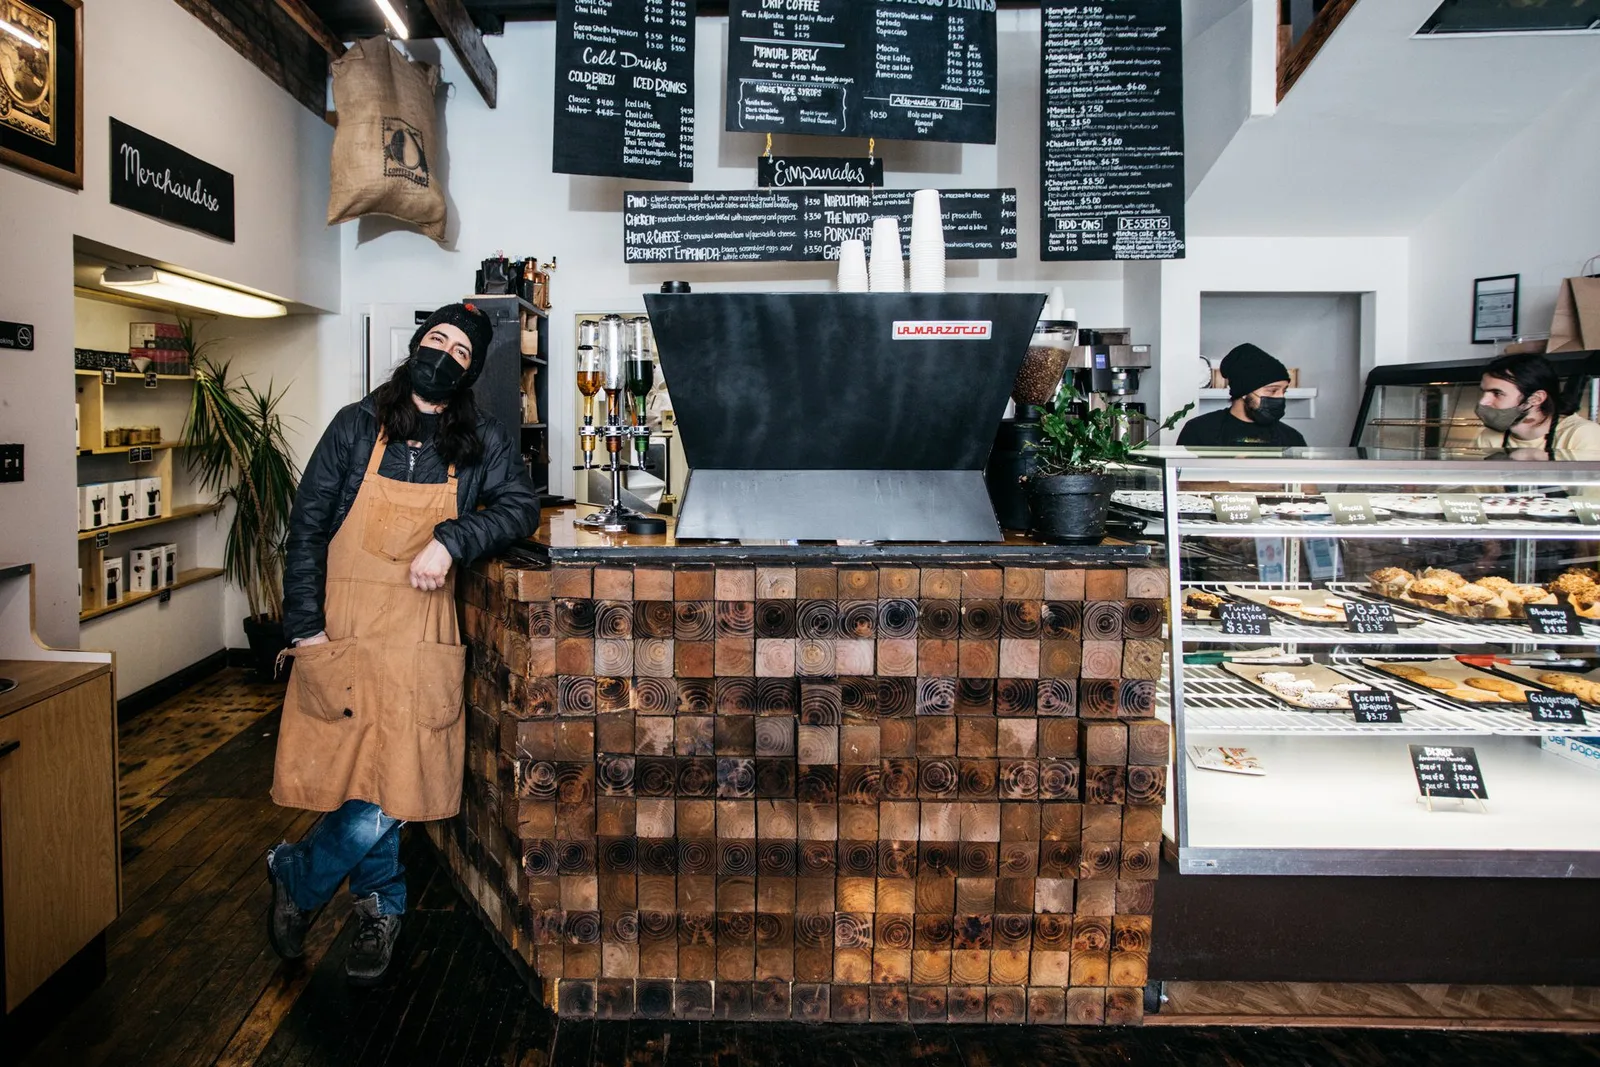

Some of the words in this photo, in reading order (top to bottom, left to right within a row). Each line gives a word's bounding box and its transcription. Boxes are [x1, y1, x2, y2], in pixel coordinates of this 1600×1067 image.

[575, 5, 588, 13] Chai
[590, 6, 607, 16] Latte
[786, 0, 820, 12] COFFEE
[817, 15, 835, 23] Roast
[876, 10, 901, 19] Espresso
[876, 19, 901, 27] Cortado
[876, 27, 908, 37] Capuccino
[574, 31, 584, 40] Hot
[586, 33, 616, 44] Chocolate
[754, 45, 789, 61] MANUAL
[792, 48, 819, 61] BREW
[876, 44, 899, 53] Mocha
[583, 47, 617, 66] Cold
[620, 52, 667, 72] Drinks
[893, 54, 911, 63] Latte
[752, 59, 764, 67] Pour
[790, 62, 810, 70] French
[811, 63, 826, 71] Press
[568, 70, 591, 82] COLD
[592, 72, 616, 85] BREW
[875, 70, 912, 79] Americano
[633, 76, 654, 90] ICED
[655, 78, 687, 94] DRINKS
[756, 85, 776, 94] HOUSE
[568, 95, 590, 104] Classic
[625, 98, 637, 107] Iced
[638, 100, 651, 110] Latte
[894, 96, 937, 107] Alternative
[939, 100, 960, 108] Milk
[625, 110, 639, 118] Chai
[639, 111, 653, 120] Latte
[870, 110, 887, 120] $0.50
[625, 120, 646, 128] Matcha
[646, 120, 661, 130] Latte
[624, 128, 636, 137] Iced
[636, 130, 665, 138] Americano
[624, 137, 637, 146] Thai
[638, 138, 646, 146] Tea
[645, 158, 662, 166] Water
[120, 143, 219, 211] Merchandise
[774, 160, 864, 187] Empanadas
[671, 195, 700, 204] empanada
[804, 196, 821, 206] $3.50
[626, 213, 658, 226] CHICKEN:
[657, 214, 686, 223] marinated
[686, 214, 704, 222] chicken
[715, 213, 730, 221] baked
[731, 213, 743, 221] with
[743, 213, 766, 223] rosemary
[766, 213, 776, 221] and
[804, 213, 821, 221] $3.50
[825, 211, 842, 224] THE
[843, 210, 871, 224] NOMAD:
[952, 211, 983, 220] prosciutto.
[1058, 219, 1101, 230] ADD-ONS
[1120, 217, 1168, 229] DESSERTS
[626, 230, 645, 244] HAM
[646, 230, 653, 244] &
[683, 232, 701, 242] cherry
[702, 232, 713, 240] wood
[714, 232, 733, 240] smoked
[732, 232, 744, 240] ham
[804, 230, 821, 238] $3.25
[824, 226, 854, 242] PORKY
[626, 246, 673, 260] BREAKFAST
[675, 247, 721, 261] EMPANADA:
[803, 245, 821, 254] $3.50
[722, 253, 738, 261] white
[1221, 504, 1251, 512] Chocolate
[1225, 604, 1260, 612] Turtle
[1221, 612, 1267, 623] Alfajores
[1530, 608, 1566, 619] Blueberry
[1352, 614, 1393, 625] Alfajores
[1226, 621, 1261, 634] $3.75
[1358, 624, 1384, 633] $3.75
[1543, 625, 1567, 633] $4.25
[1354, 693, 1390, 702] Coconut
[1359, 703, 1393, 712] Alfajores
[1539, 706, 1572, 718] $2.25
[1366, 711, 1388, 721] $3.75
